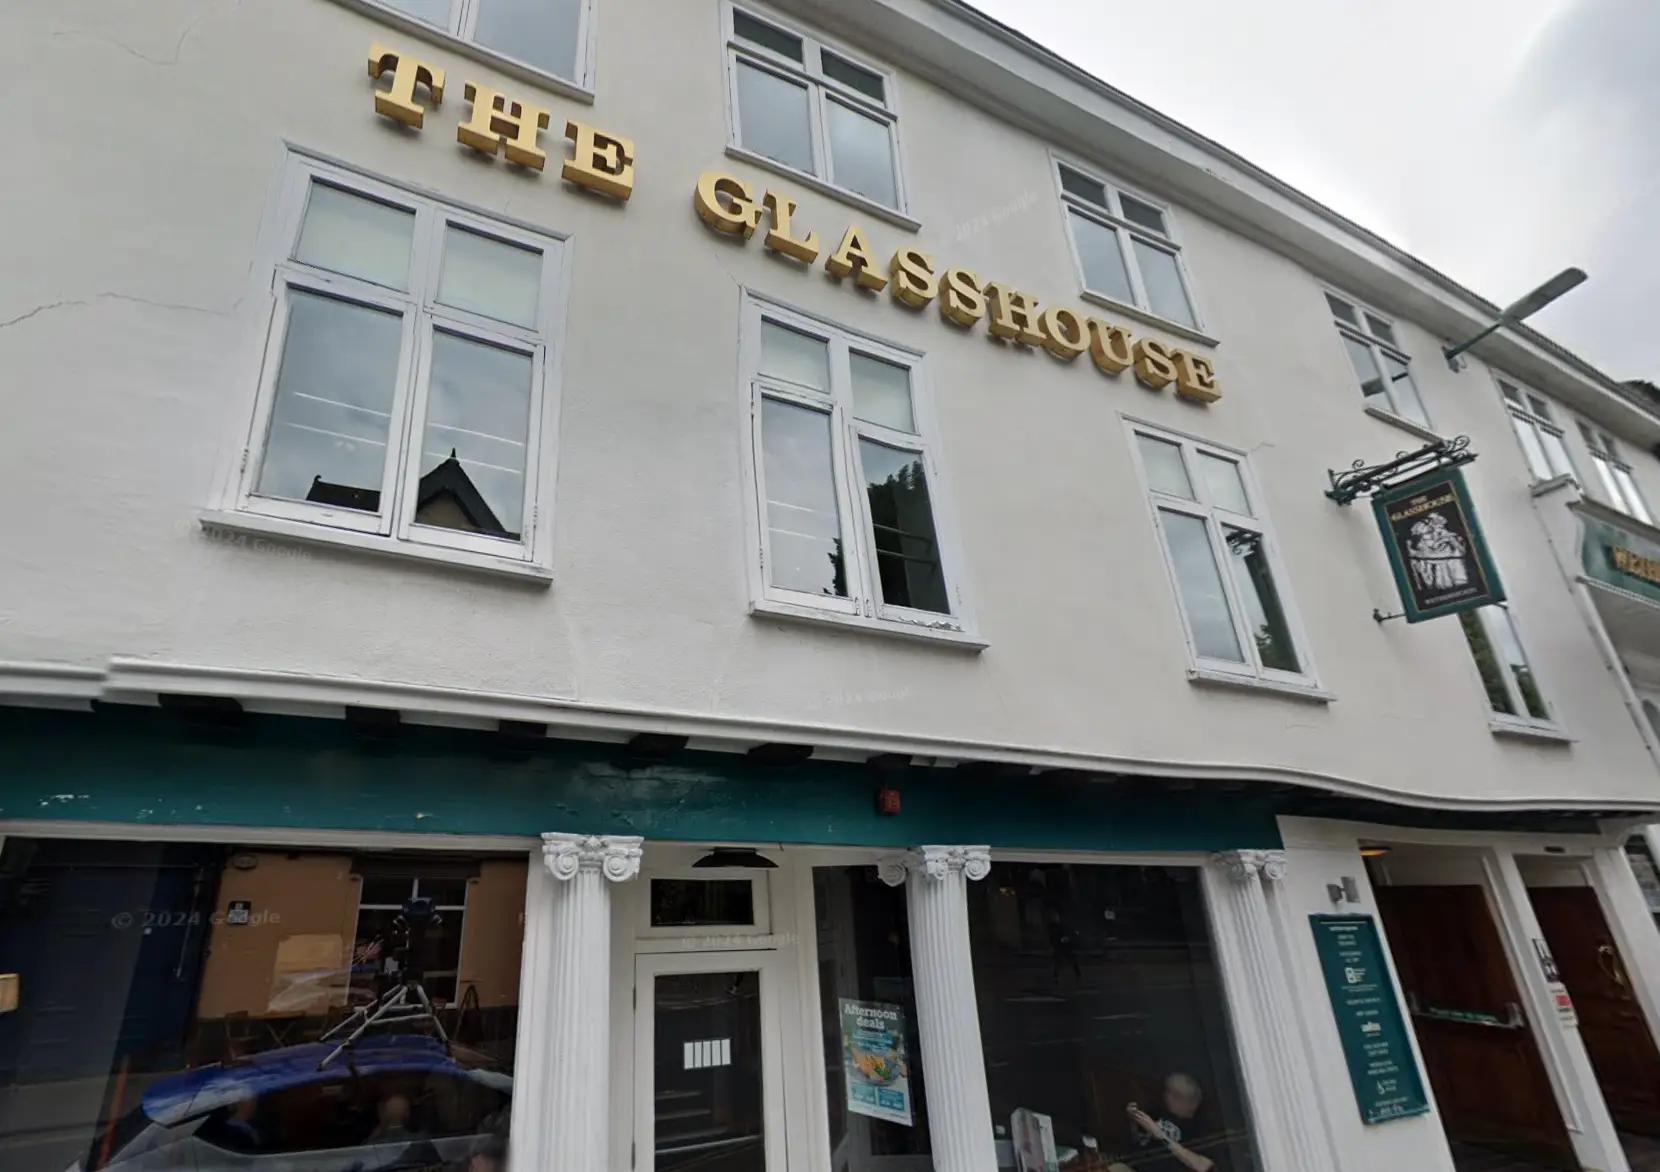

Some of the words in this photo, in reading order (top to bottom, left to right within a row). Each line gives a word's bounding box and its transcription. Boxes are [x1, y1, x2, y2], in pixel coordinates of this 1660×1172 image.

[368, 43, 633, 202] THE
[694, 171, 1222, 403] GLASSHOUSE
[844, 1003, 898, 1020] Afternoon
[856, 1016, 885, 1030] deals
